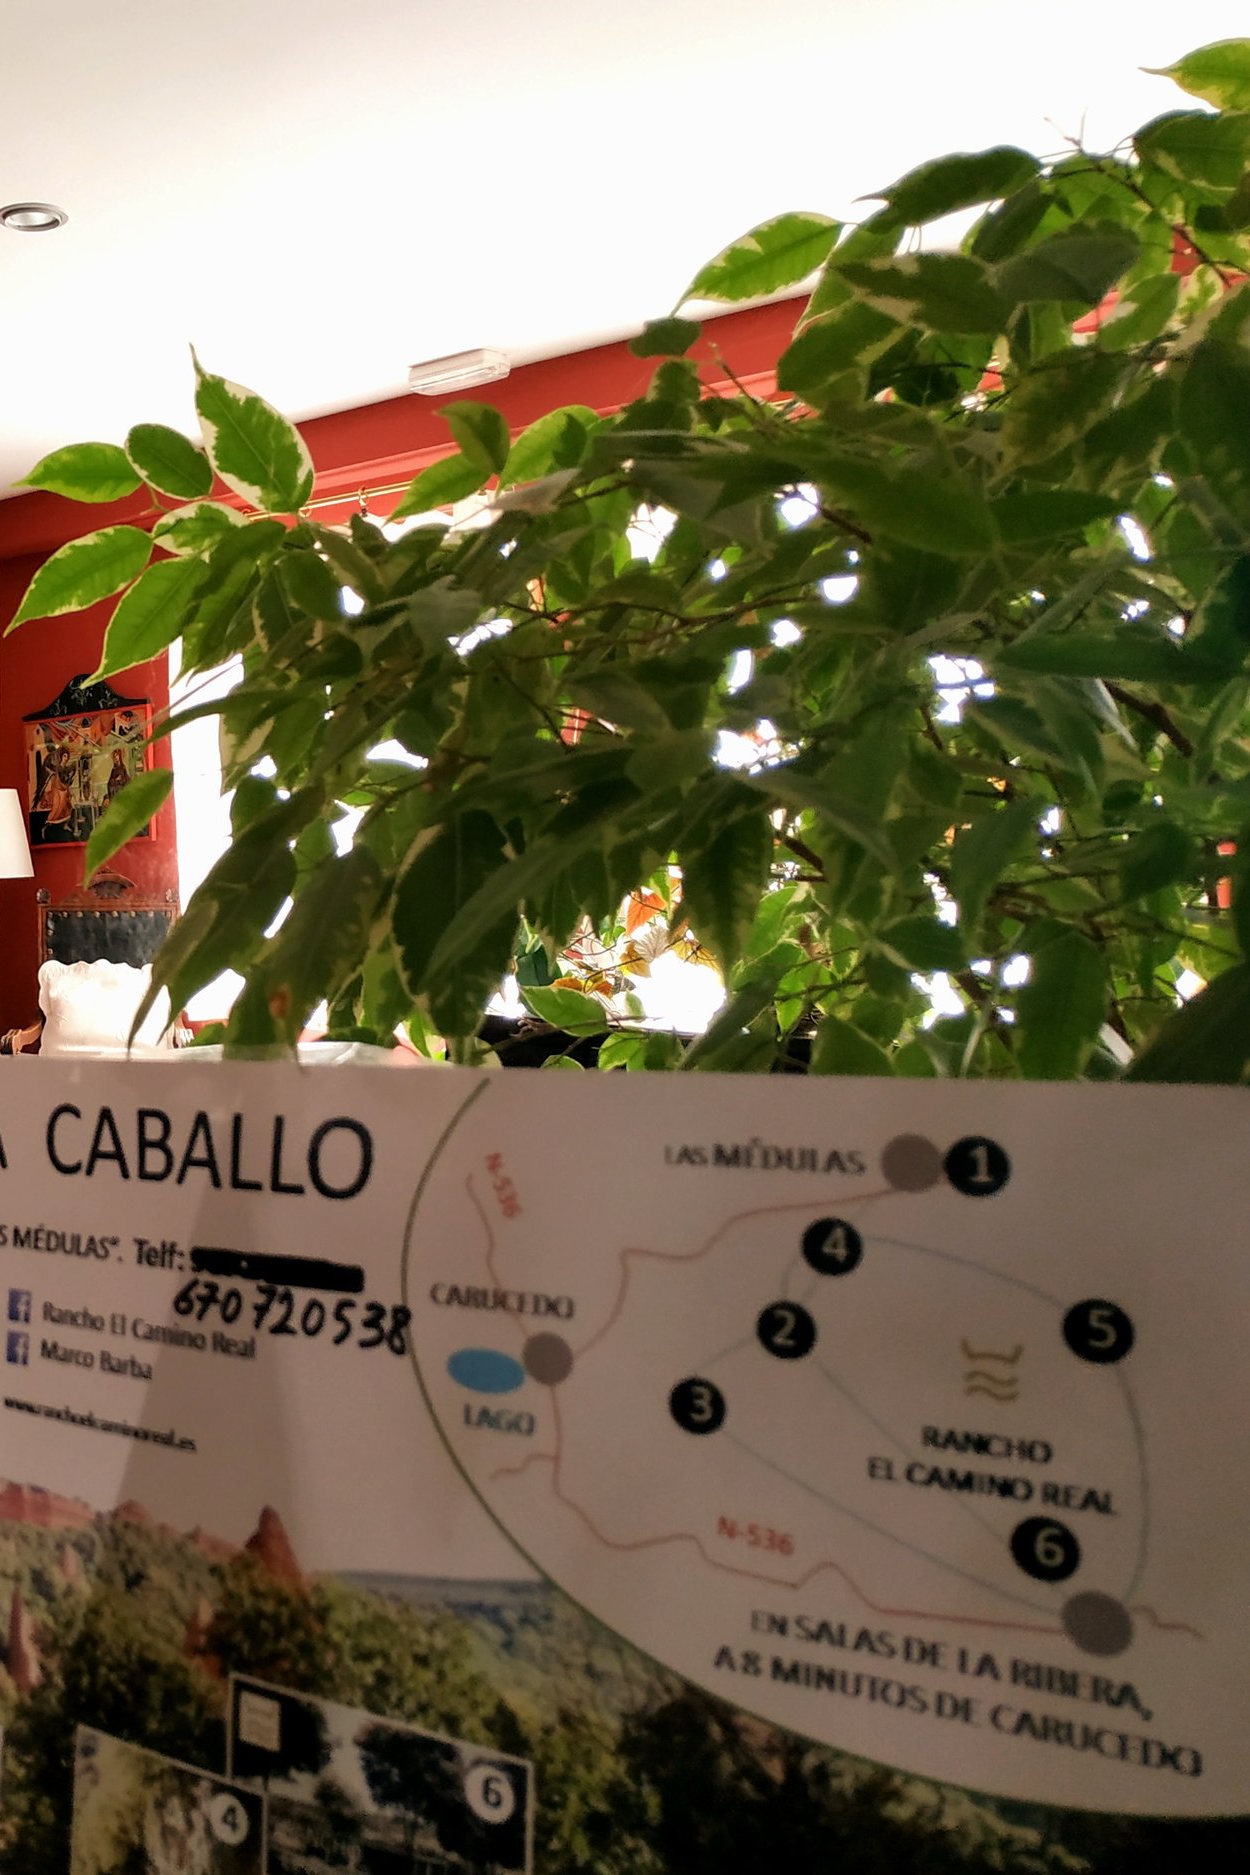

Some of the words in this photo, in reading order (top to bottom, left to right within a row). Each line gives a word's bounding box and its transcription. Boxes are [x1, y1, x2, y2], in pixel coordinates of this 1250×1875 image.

[45, 1102, 374, 1200] CABALLO
[664, 1144, 708, 1167] LAS
[712, 1137, 867, 1176] MÉDULAS
[133, 1237, 186, 1272] Telf:
[430, 1282, 576, 1319] CARUCEDO
[43, 1300, 105, 1331] Rancho
[110, 1312, 126, 1336] El
[132, 1317, 207, 1350] Camino
[212, 1330, 257, 1359] Real
[41, 1338, 94, 1368] Marco
[100, 1349, 152, 1380] Barba
[463, 1402, 536, 1436] LAGO
[922, 1425, 1053, 1464] RANCHO
[867, 1456, 896, 1482] EL
[905, 1461, 1033, 1500] CAMINO
[1041, 1482, 1118, 1516] REAL
[717, 1515, 794, 1556] N-536
[751, 1609, 788, 1637] EN
[794, 1614, 898, 1660] SALAS
[903, 1635, 948, 1670] DE
[958, 1647, 1001, 1681] LA
[1010, 1656, 1153, 1722] RIBERA,
[713, 1644, 736, 1673] A
[741, 1649, 762, 1677] 8
[770, 1655, 929, 1715] MINUTOS
[934, 1690, 980, 1727] DE
[989, 1703, 1203, 1778] CARUCEDO
